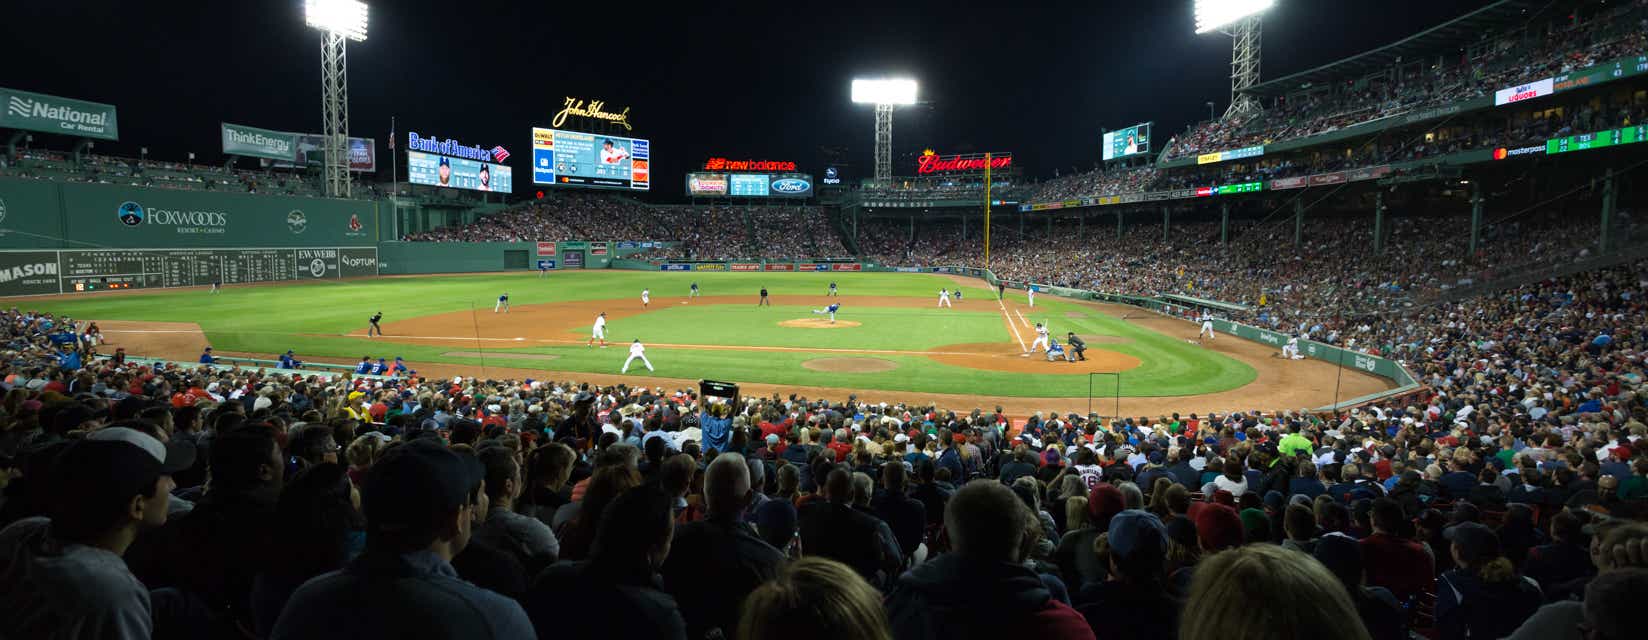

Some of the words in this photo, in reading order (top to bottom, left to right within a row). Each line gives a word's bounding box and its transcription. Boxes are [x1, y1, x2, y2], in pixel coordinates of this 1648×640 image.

[1508, 90, 1537, 102] LIQUORS
[32, 102, 107, 125] National
[552, 96, 586, 127] John
[585, 99, 632, 131] Hancock
[60, 122, 76, 130] Car
[78, 124, 104, 133] Rental
[226, 128, 289, 152] ThinkEnergy
[408, 131, 439, 153] Bank
[440, 138, 451, 155] of
[451, 139, 491, 161] America
[1507, 145, 1546, 156] masterpass
[726, 160, 749, 170] new
[749, 159, 795, 171] balance
[779, 180, 802, 191] Ford
[147, 207, 226, 226] FOXWOODS
[350, 258, 376, 267] OPTUM
[0, 262, 57, 282] MASON
